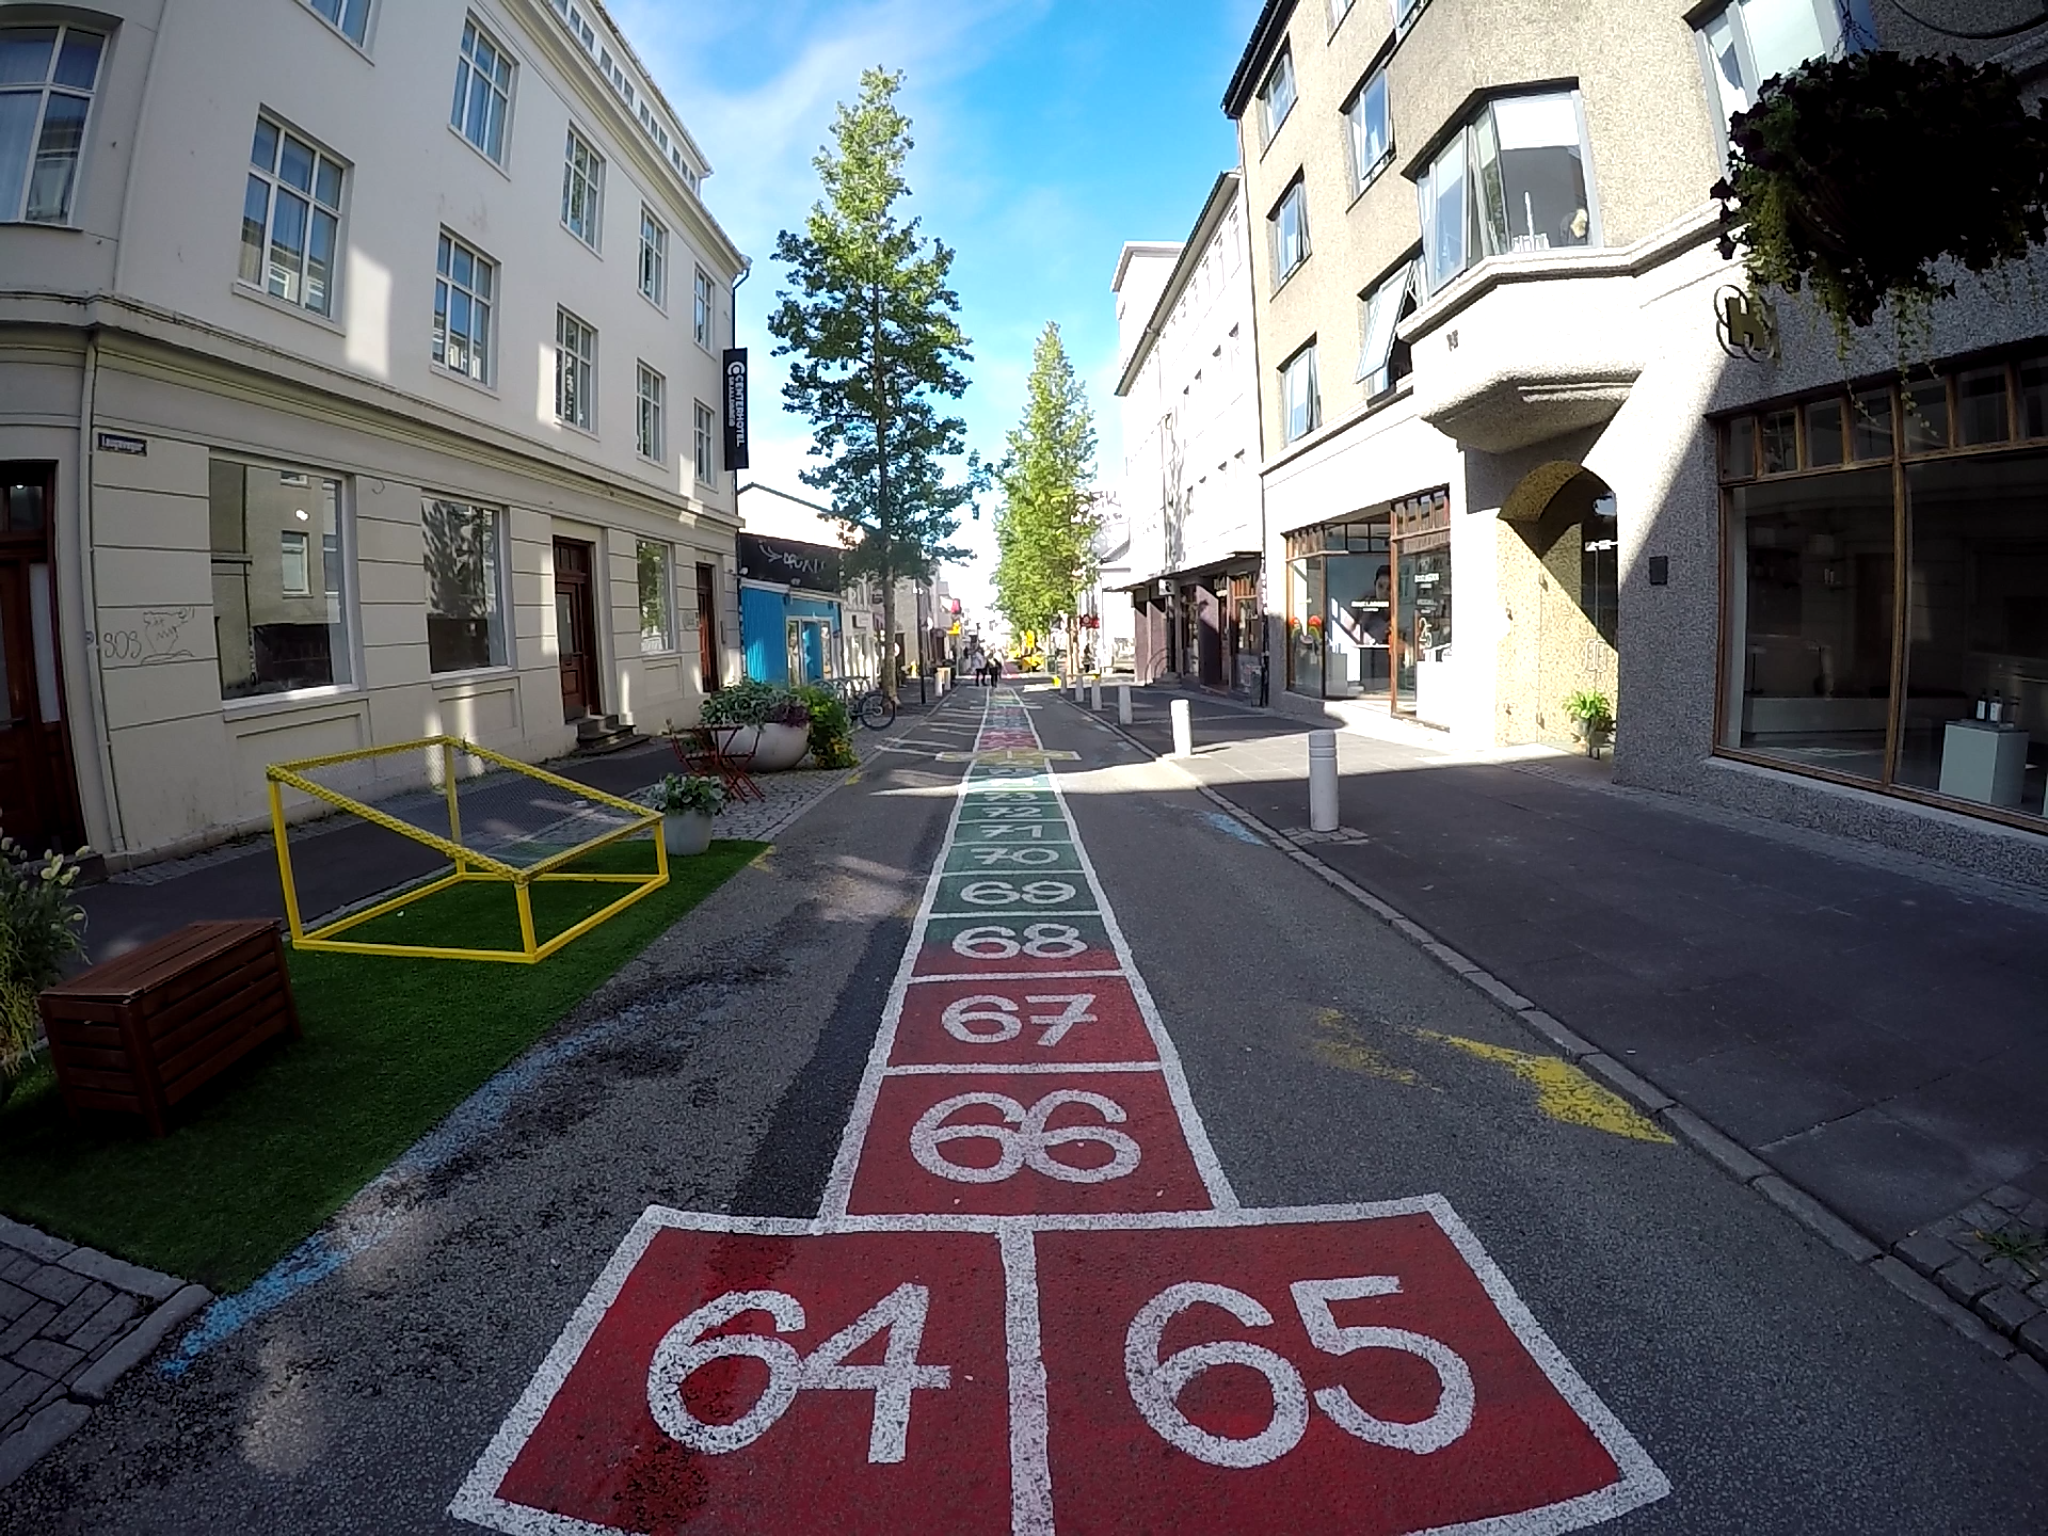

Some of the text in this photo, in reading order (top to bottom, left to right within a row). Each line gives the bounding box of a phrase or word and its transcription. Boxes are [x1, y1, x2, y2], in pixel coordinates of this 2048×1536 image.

[734, 374, 745, 448] CENTERHOTEL
[982, 806, 1043, 818] 72
[984, 791, 1039, 802] 73
[980, 824, 1043, 838] 71
[970, 847, 1059, 865] 70
[960, 880, 1076, 905] 69
[951, 922, 1088, 960] 68
[941, 993, 1099, 1047] 67
[909, 1089, 1142, 1184] 66
[646, 1281, 951, 1463] 64
[1124, 1273, 1476, 1469] 65
